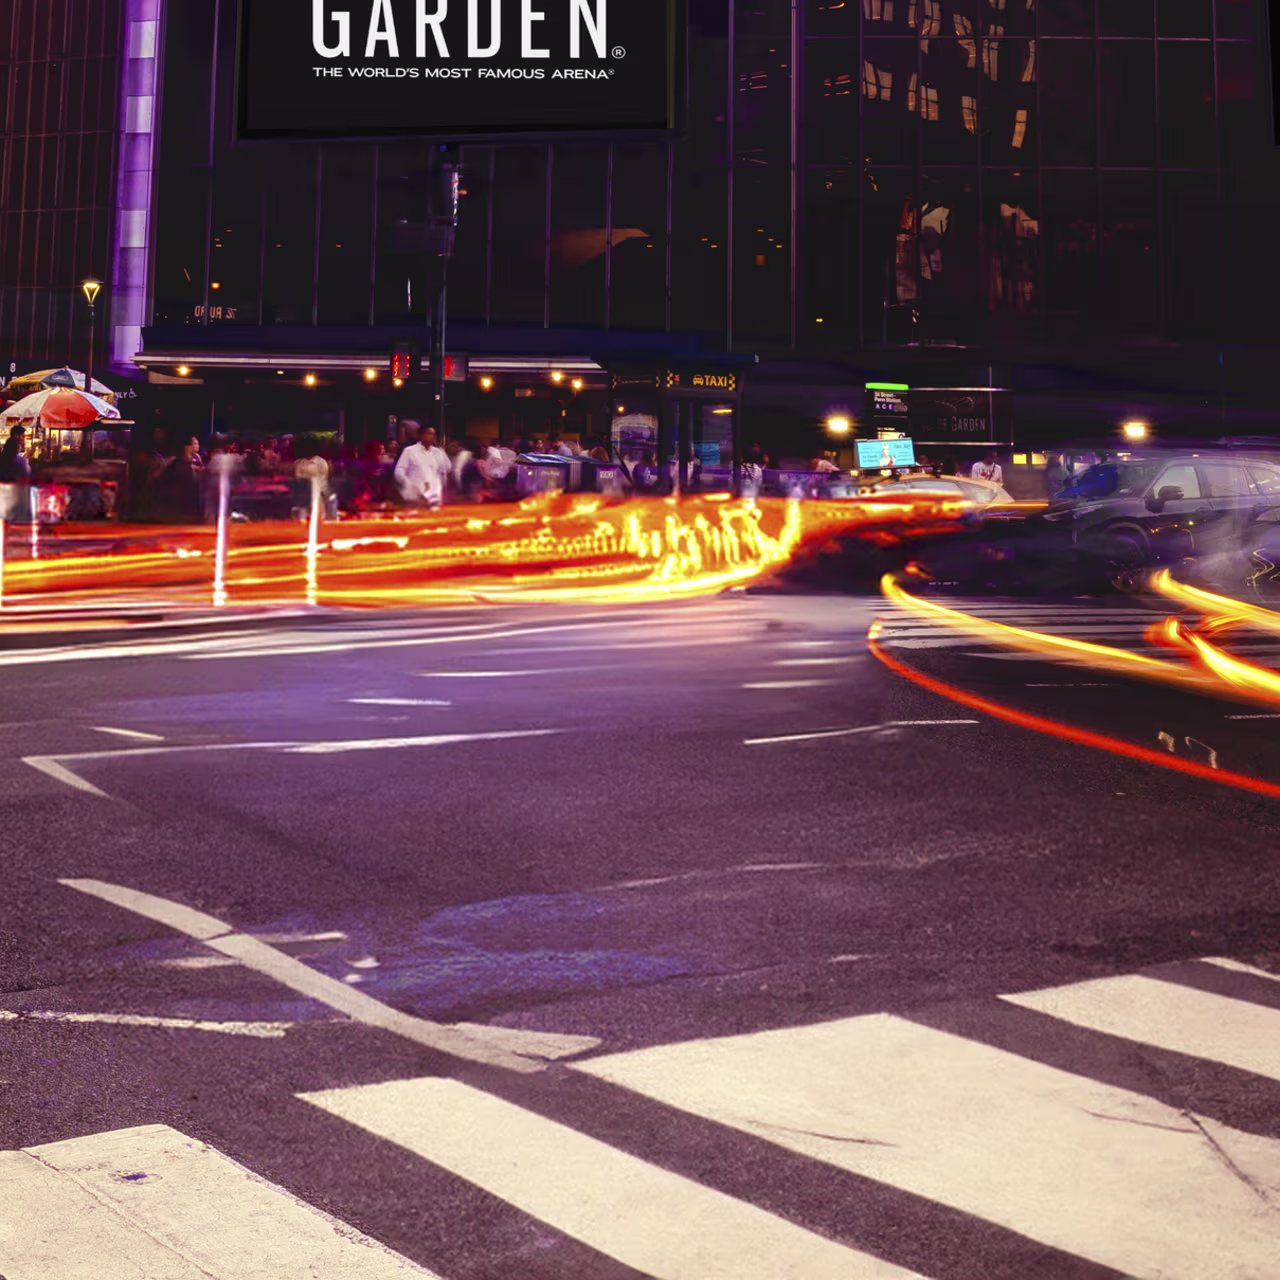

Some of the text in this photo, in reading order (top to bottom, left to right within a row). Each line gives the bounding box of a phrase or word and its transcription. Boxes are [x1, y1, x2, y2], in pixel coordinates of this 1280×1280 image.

[313, 67, 343, 78] THE
[348, 67, 420, 79] WORLD'S
[425, 67, 472, 79] MOST
[478, 68, 545, 79] FAMOUS
[9, 362, 16, 373] 8
[704, 375, 727, 387] TAXI
